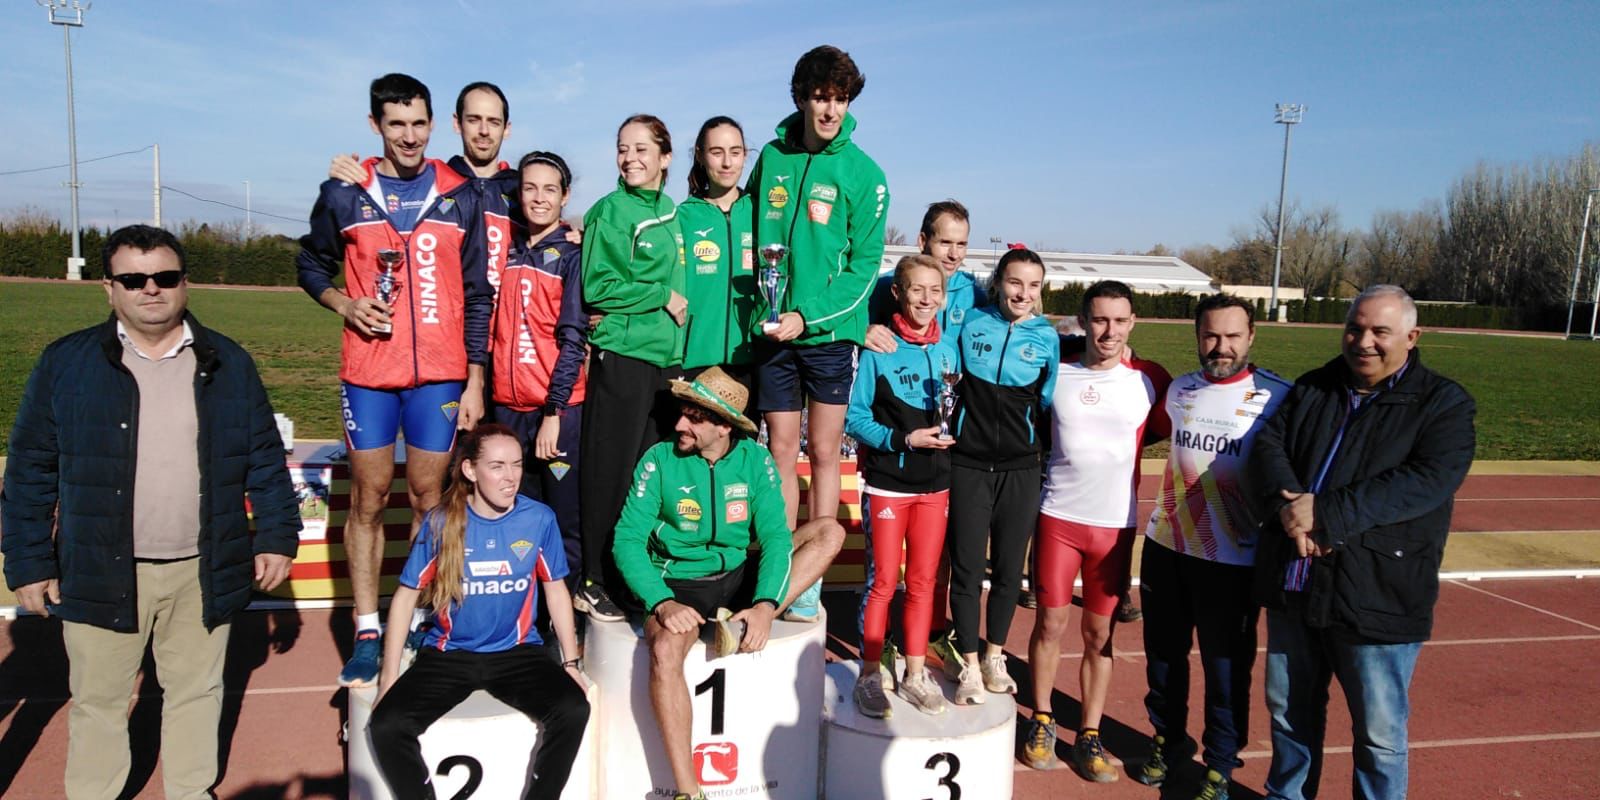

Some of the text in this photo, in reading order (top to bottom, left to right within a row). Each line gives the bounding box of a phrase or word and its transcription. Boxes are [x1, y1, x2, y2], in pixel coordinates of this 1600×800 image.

[415, 232, 440, 325] HINACO
[1195, 416, 1214, 424] CAJA
[1214, 419, 1239, 428] RURAL
[1175, 429, 1243, 457] ARAGÓN
[677, 500, 701, 515] Intec
[463, 577, 529, 596] inaco
[694, 668, 726, 735] 1
[436, 755, 484, 800] 2
[734, 786, 748, 796] de
[750, 784, 760, 794] la
[924, 752, 961, 800] 3
